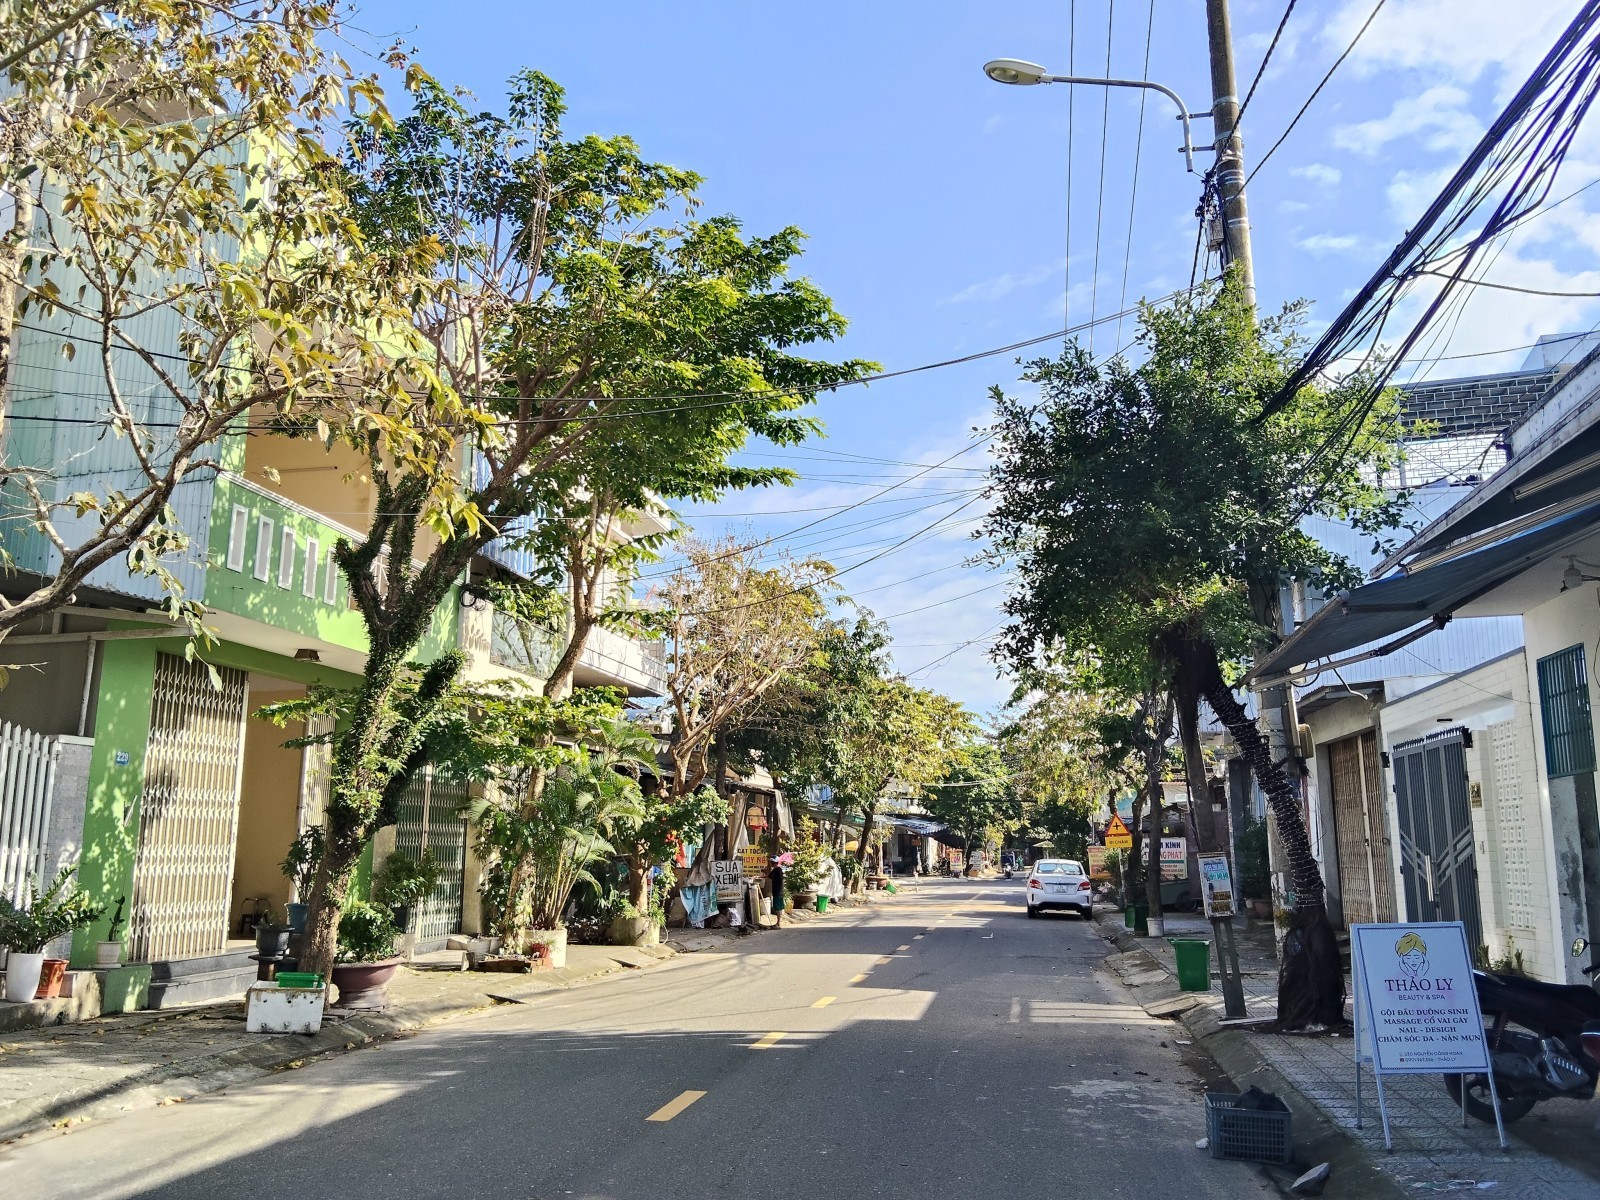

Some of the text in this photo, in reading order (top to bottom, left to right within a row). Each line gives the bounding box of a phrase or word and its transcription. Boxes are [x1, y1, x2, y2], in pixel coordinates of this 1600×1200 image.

[1166, 841, 1180, 849] KÍNH
[1385, 976, 1453, 991] THẢO LY
[1380, 1008, 1395, 1016] GỘI
